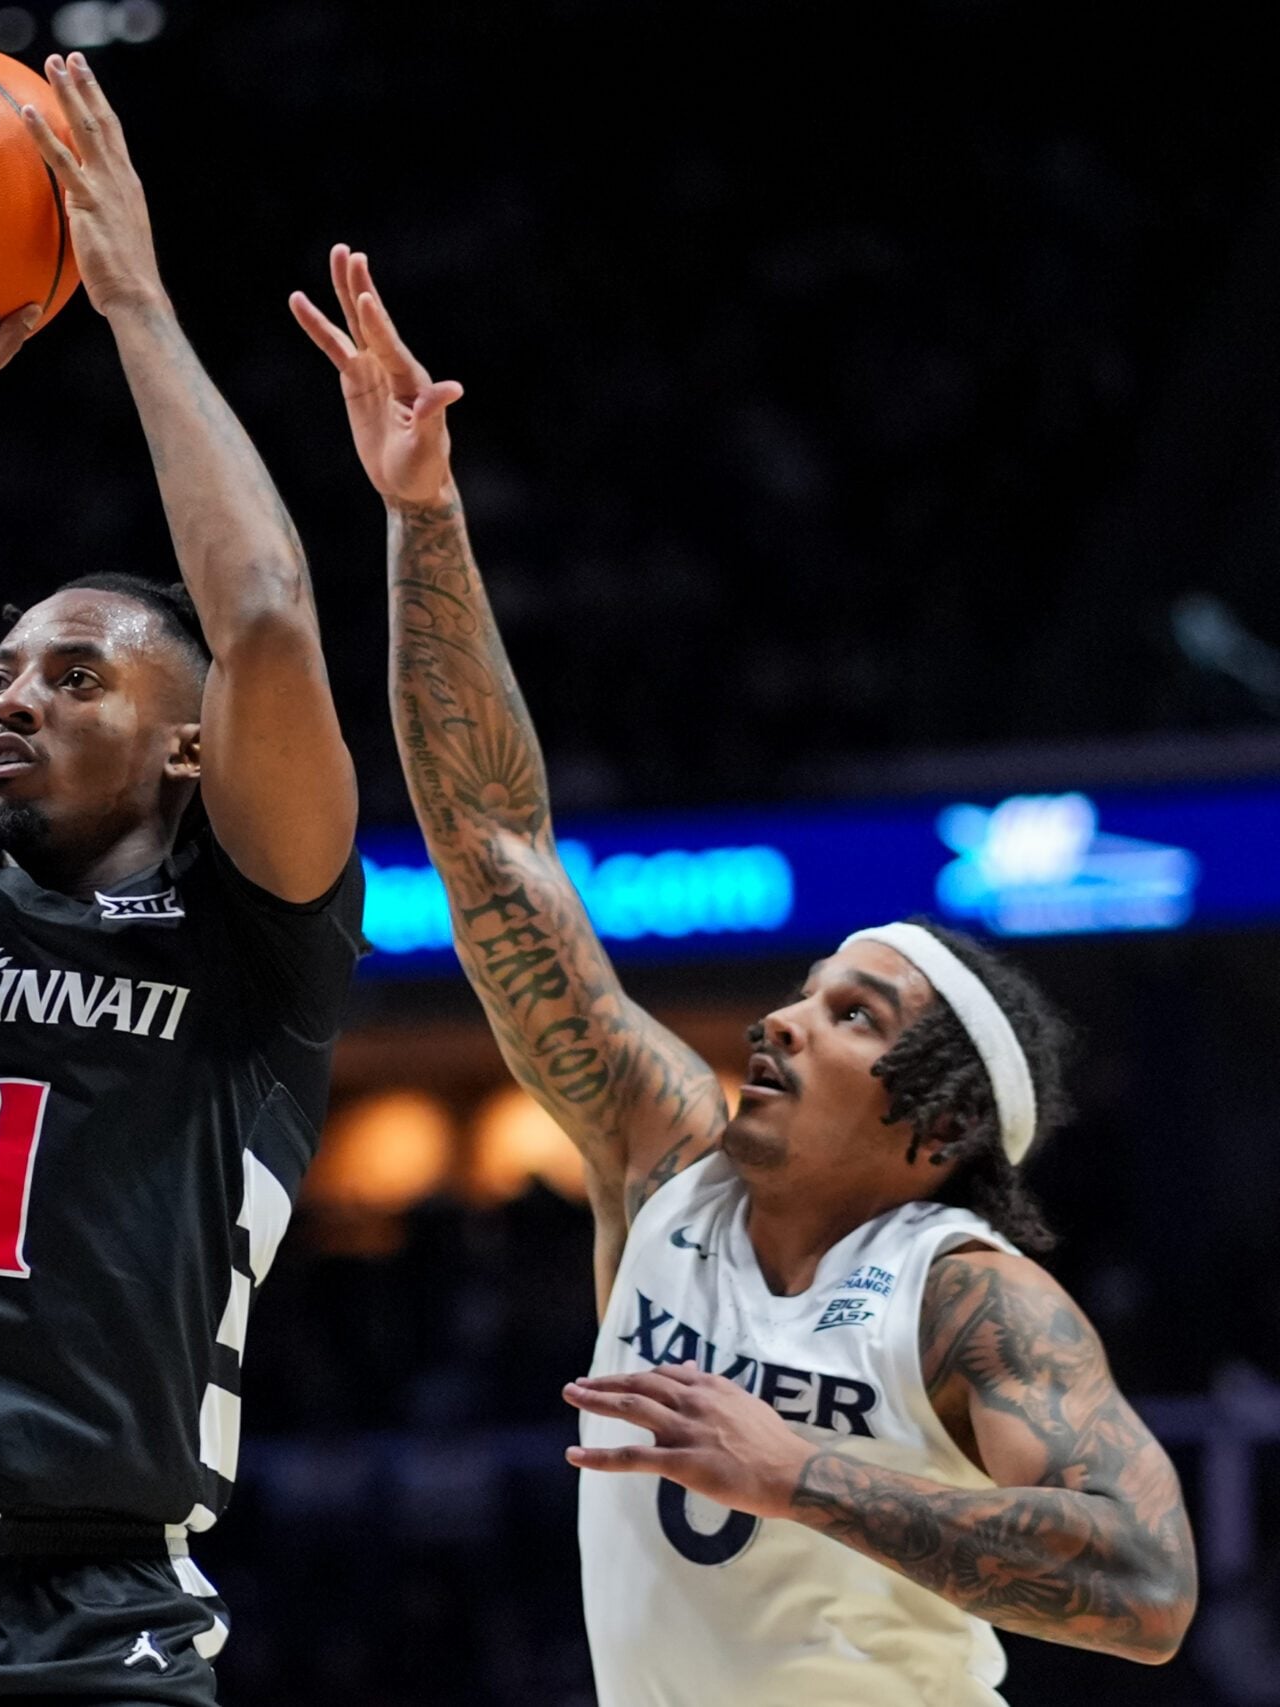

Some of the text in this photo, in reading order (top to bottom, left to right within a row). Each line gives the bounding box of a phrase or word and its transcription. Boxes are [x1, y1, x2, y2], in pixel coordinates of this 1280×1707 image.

[462, 881, 609, 1104] FEAR GOD
[866, 1266, 895, 1284] THE
[827, 1298, 868, 1311] BIG
[818, 1310, 875, 1325] EAST
